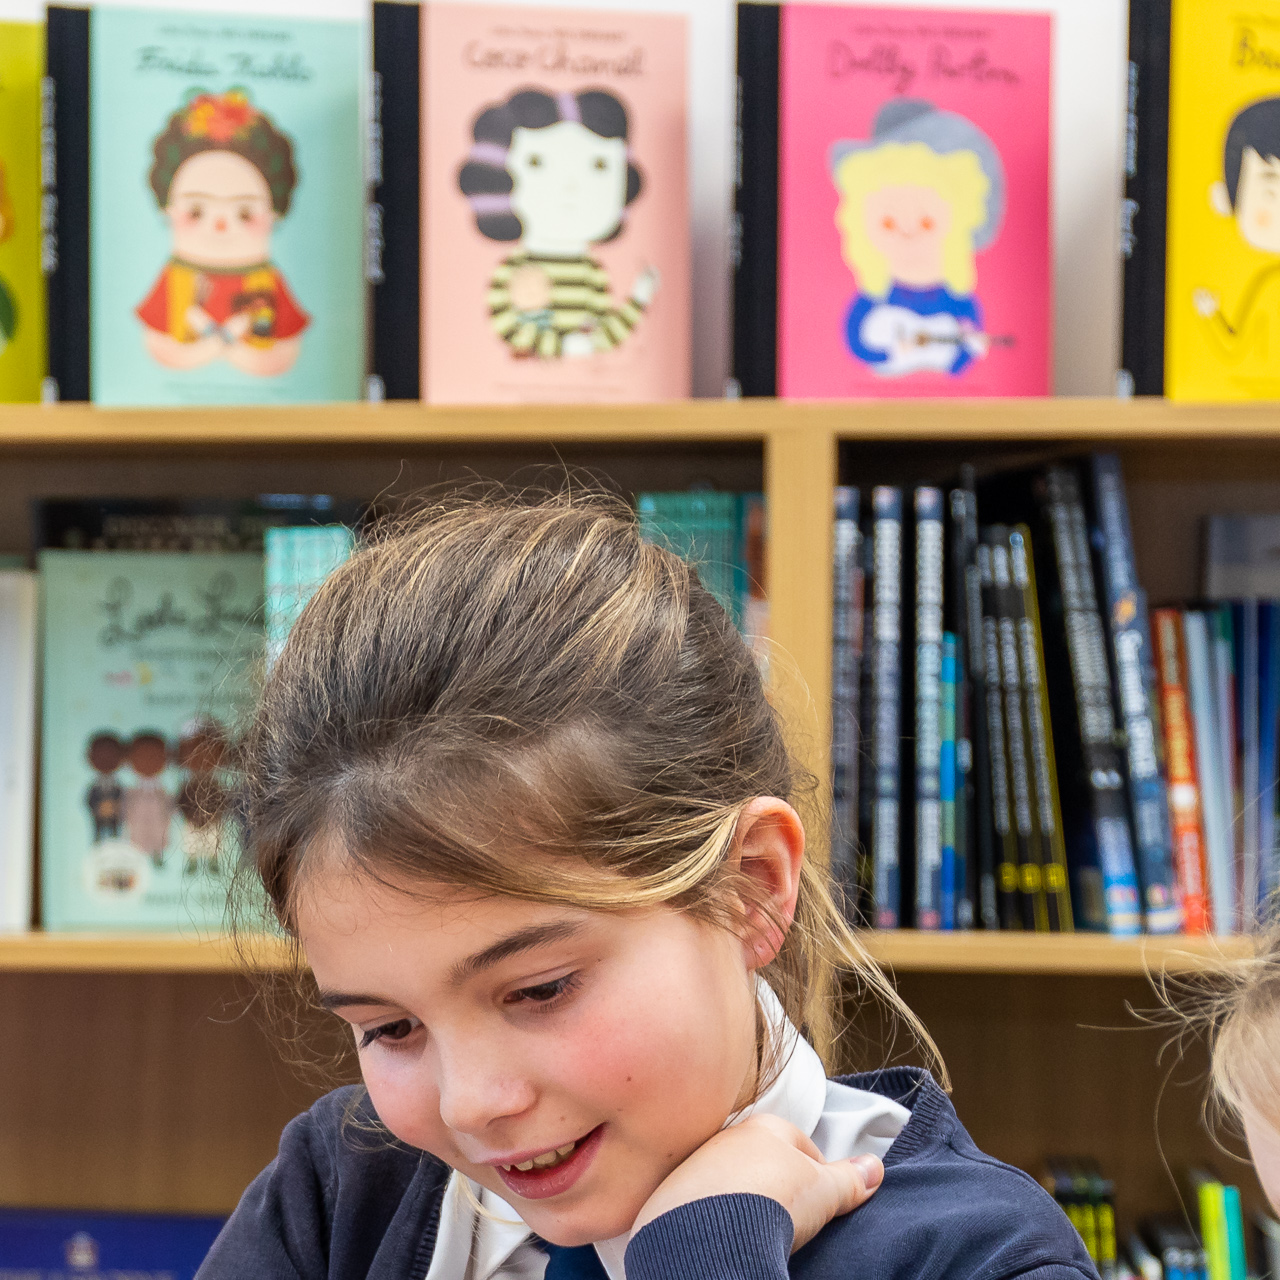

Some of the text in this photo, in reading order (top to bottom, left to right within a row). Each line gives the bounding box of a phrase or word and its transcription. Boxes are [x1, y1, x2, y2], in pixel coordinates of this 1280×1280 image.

[461, 37, 646, 77] Coco Chanel
[825, 39, 1020, 94] Dolly Parton
